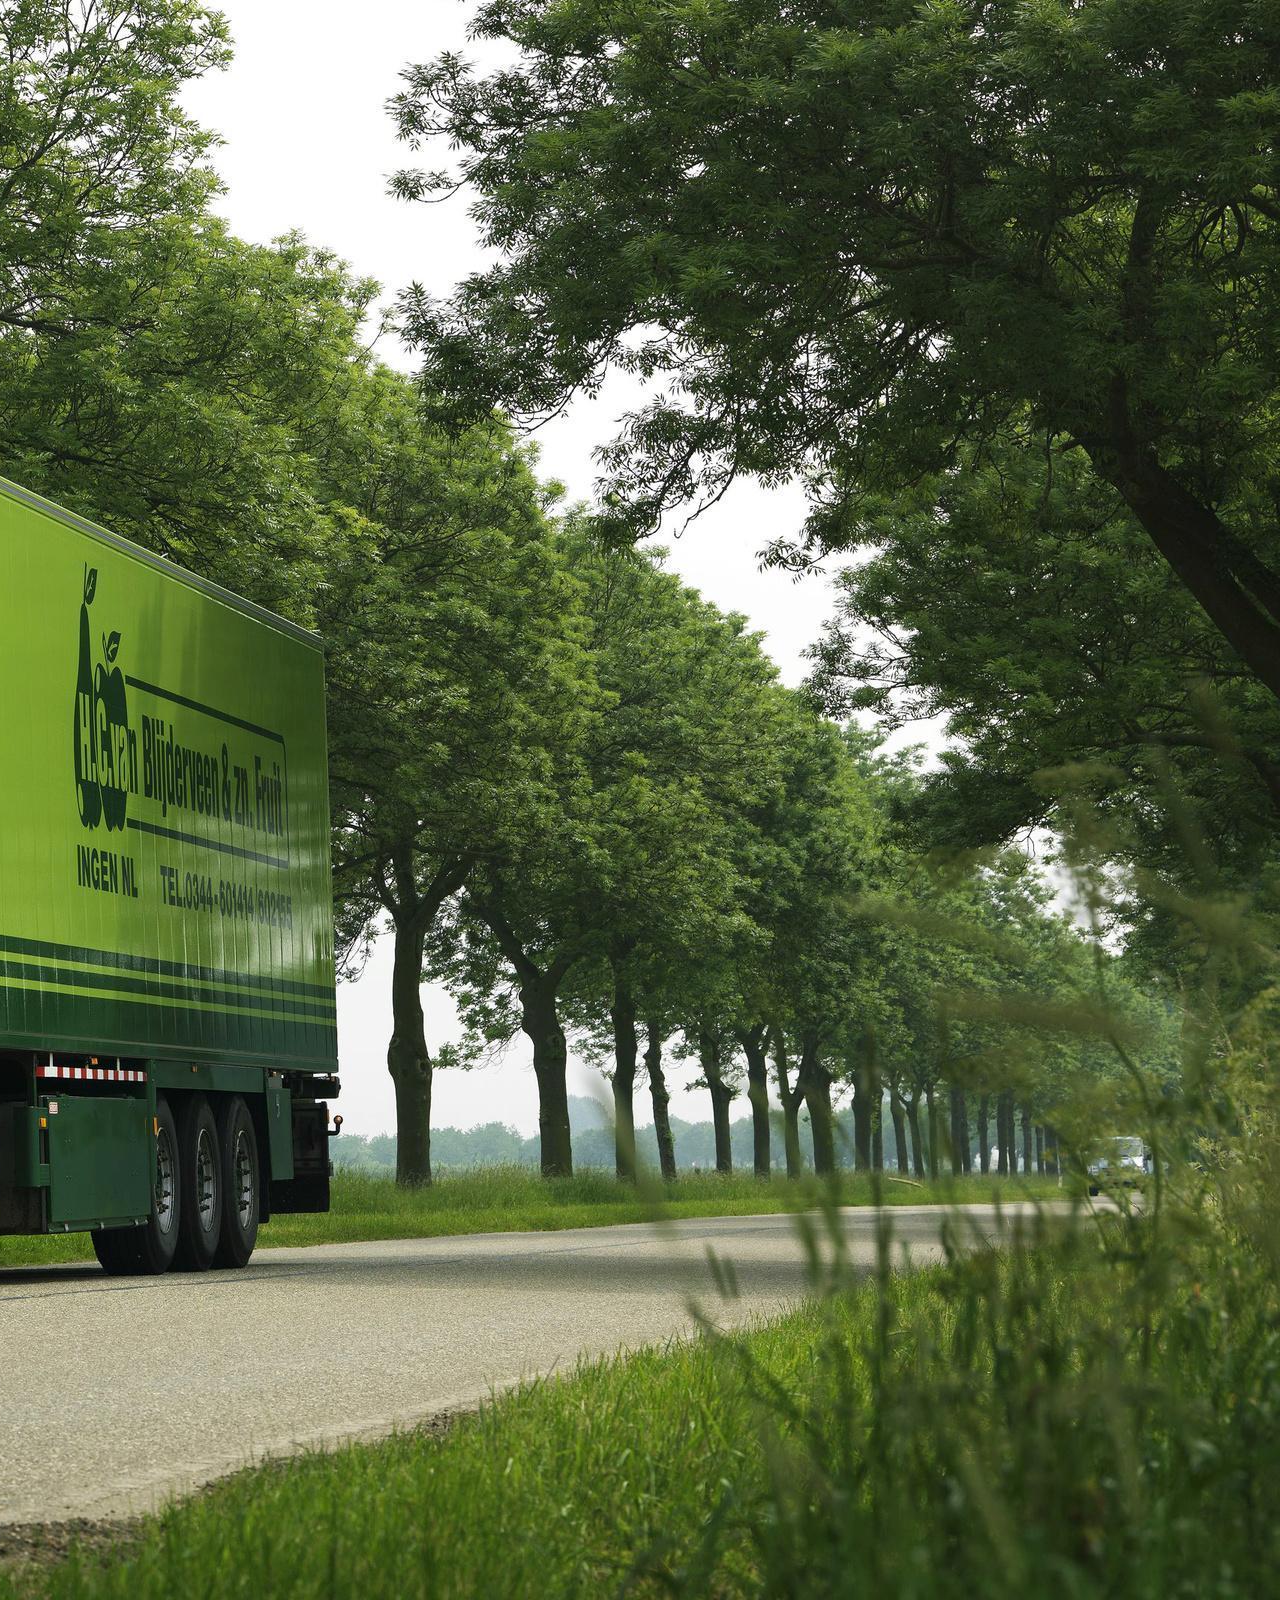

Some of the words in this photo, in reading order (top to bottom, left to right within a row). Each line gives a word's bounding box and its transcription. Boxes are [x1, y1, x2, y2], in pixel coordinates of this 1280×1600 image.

[142, 714, 220, 818] Blijderveen
[222, 742, 232, 822] &
[234, 766, 253, 828] zn.
[255, 755, 283, 837] Fruit
[77, 844, 119, 894] INGEN
[121, 855, 138, 898] NL
